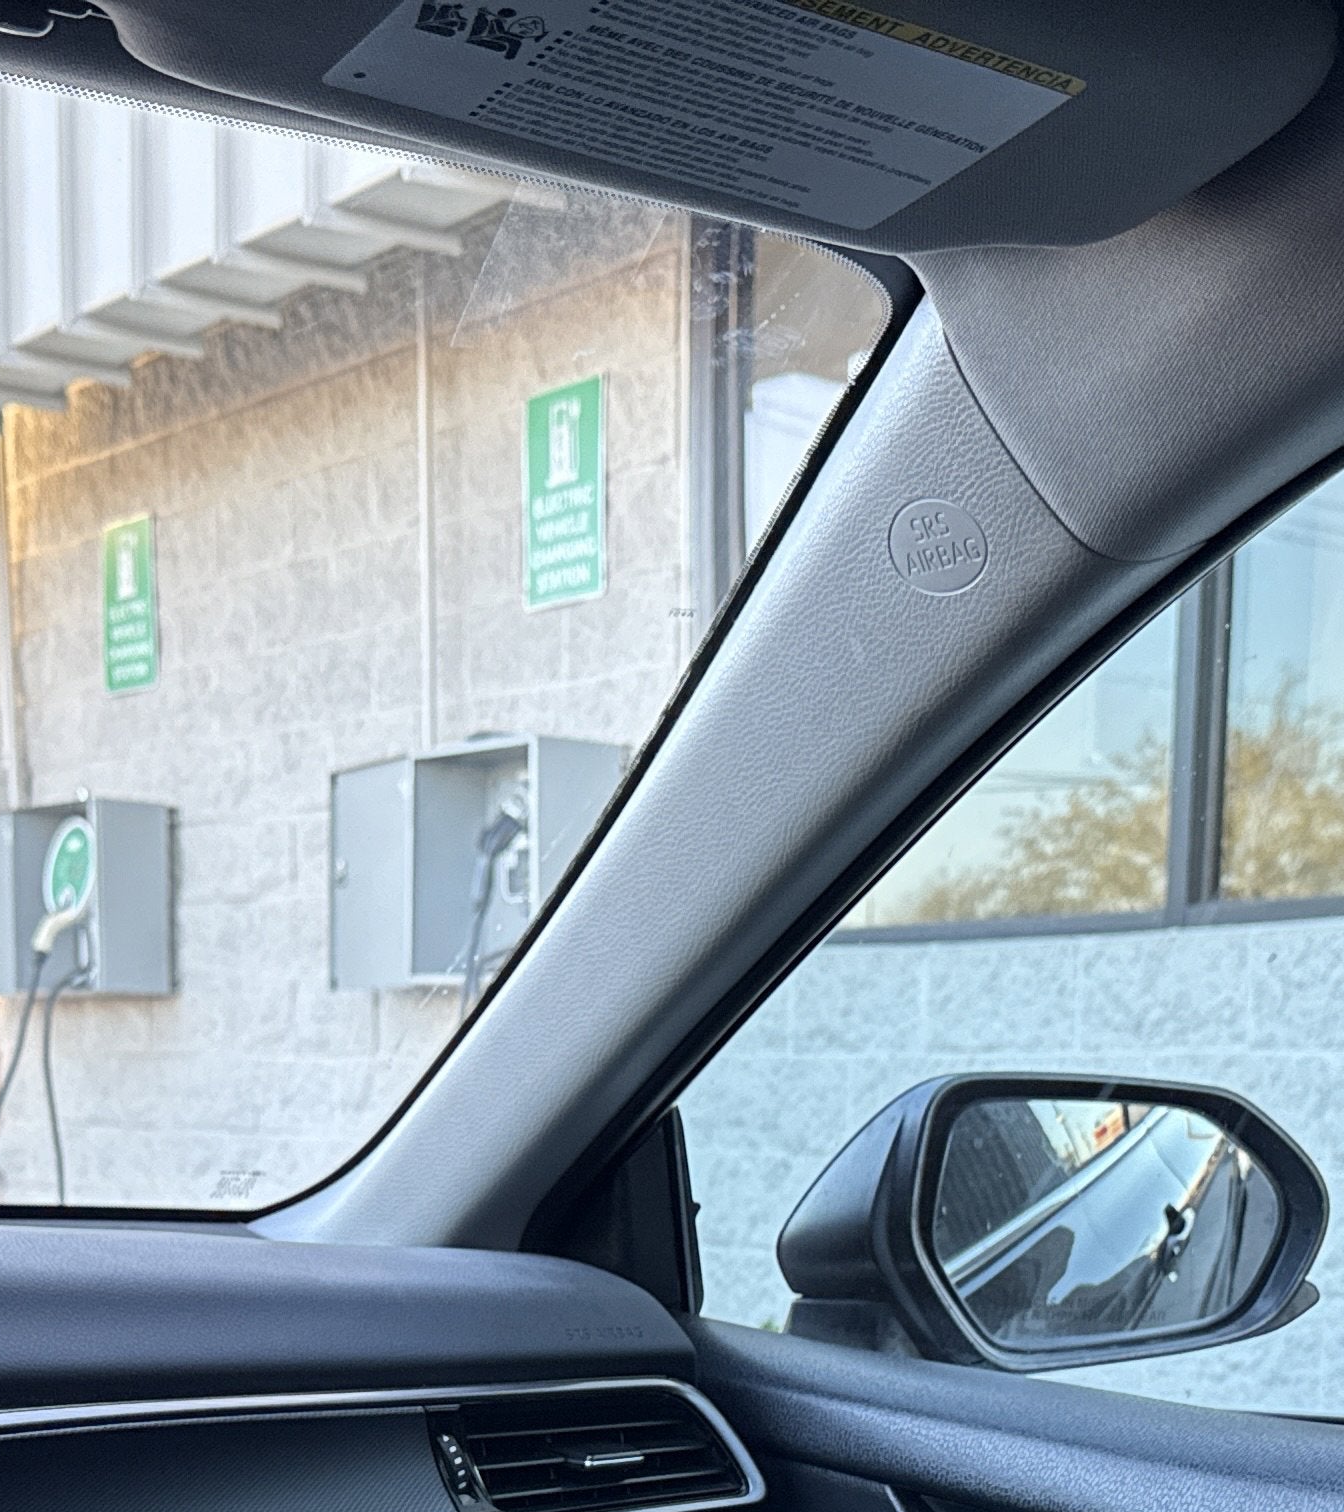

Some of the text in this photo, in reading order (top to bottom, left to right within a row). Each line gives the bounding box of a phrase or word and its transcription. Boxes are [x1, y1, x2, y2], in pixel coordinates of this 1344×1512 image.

[788, 0, 904, 34] SEMENT
[913, 31, 1074, 90] ADVERTENCIA
[910, 511, 951, 544] SRS
[906, 536, 983, 577] AIRBAG
